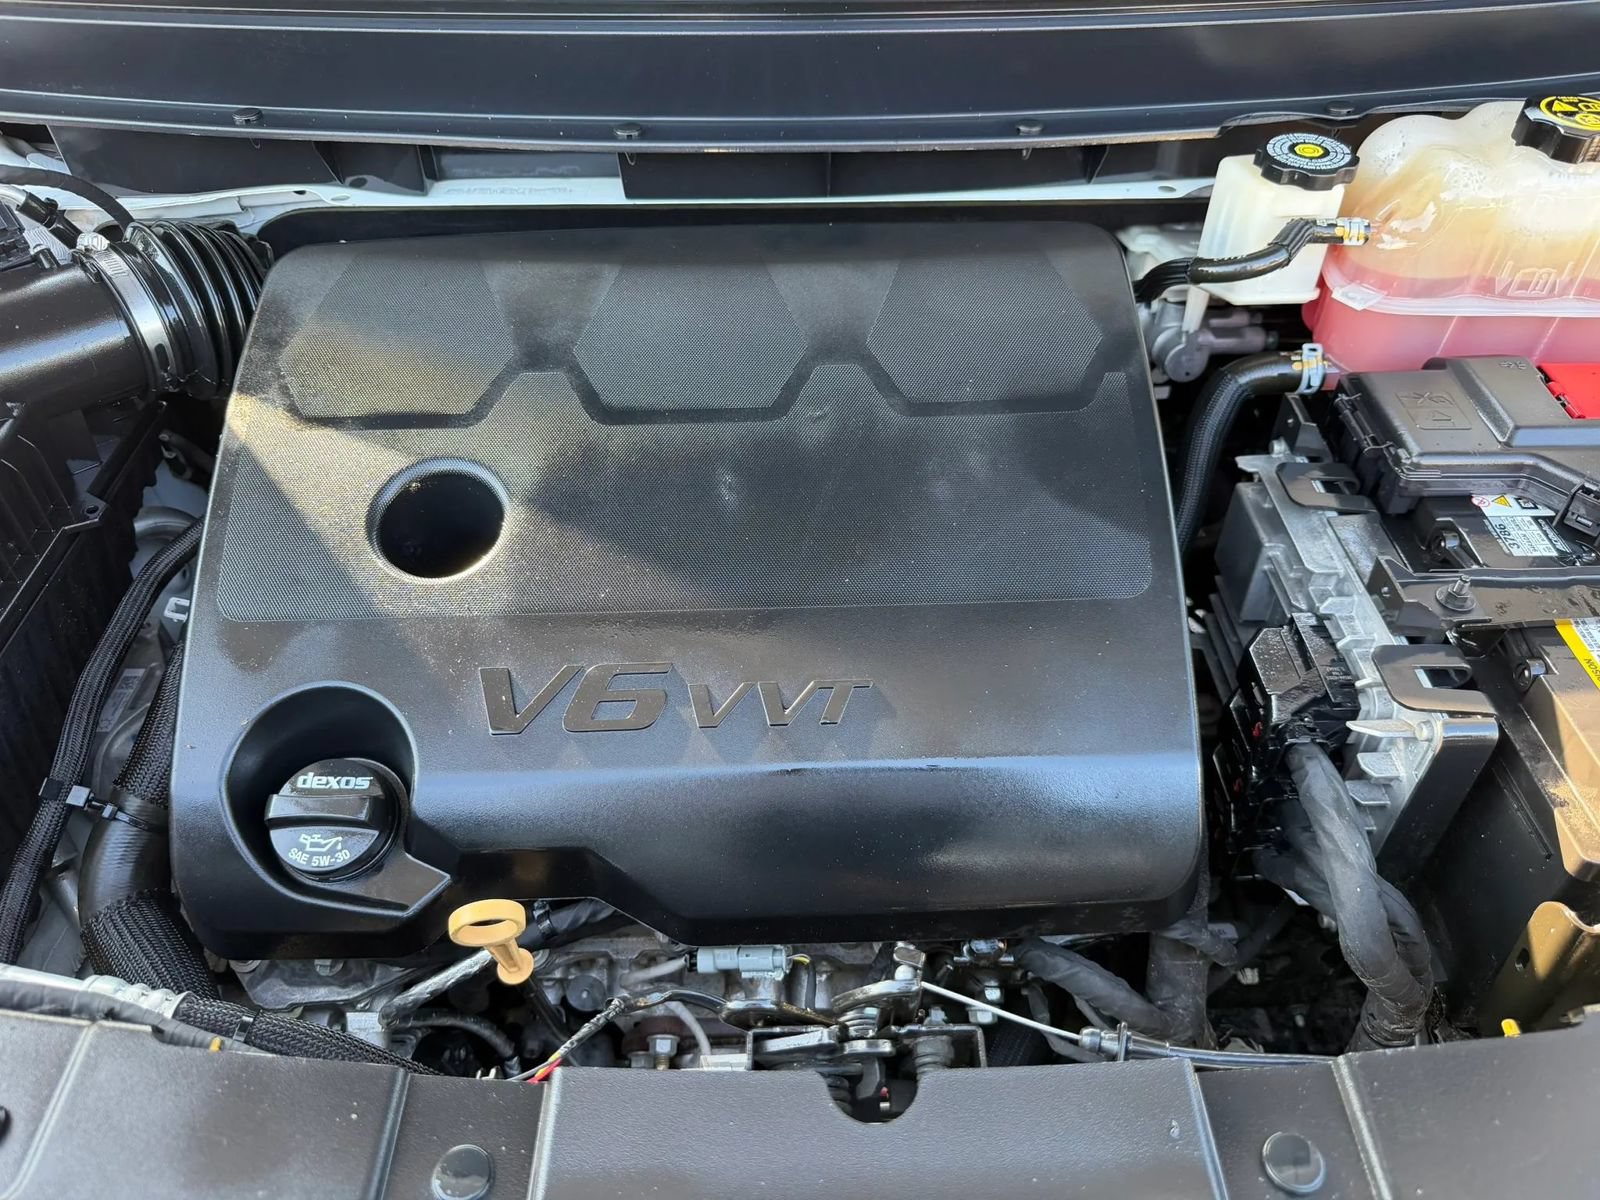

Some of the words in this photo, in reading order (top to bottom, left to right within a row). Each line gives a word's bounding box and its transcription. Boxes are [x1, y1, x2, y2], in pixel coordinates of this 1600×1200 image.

[1494, 523, 1520, 549] 3786
[479, 662, 673, 736] V6
[687, 679, 873, 728] VVT
[296, 771, 374, 789] dexos
[288, 847, 309, 865] SAE
[311, 849, 351, 867] 5W-30
